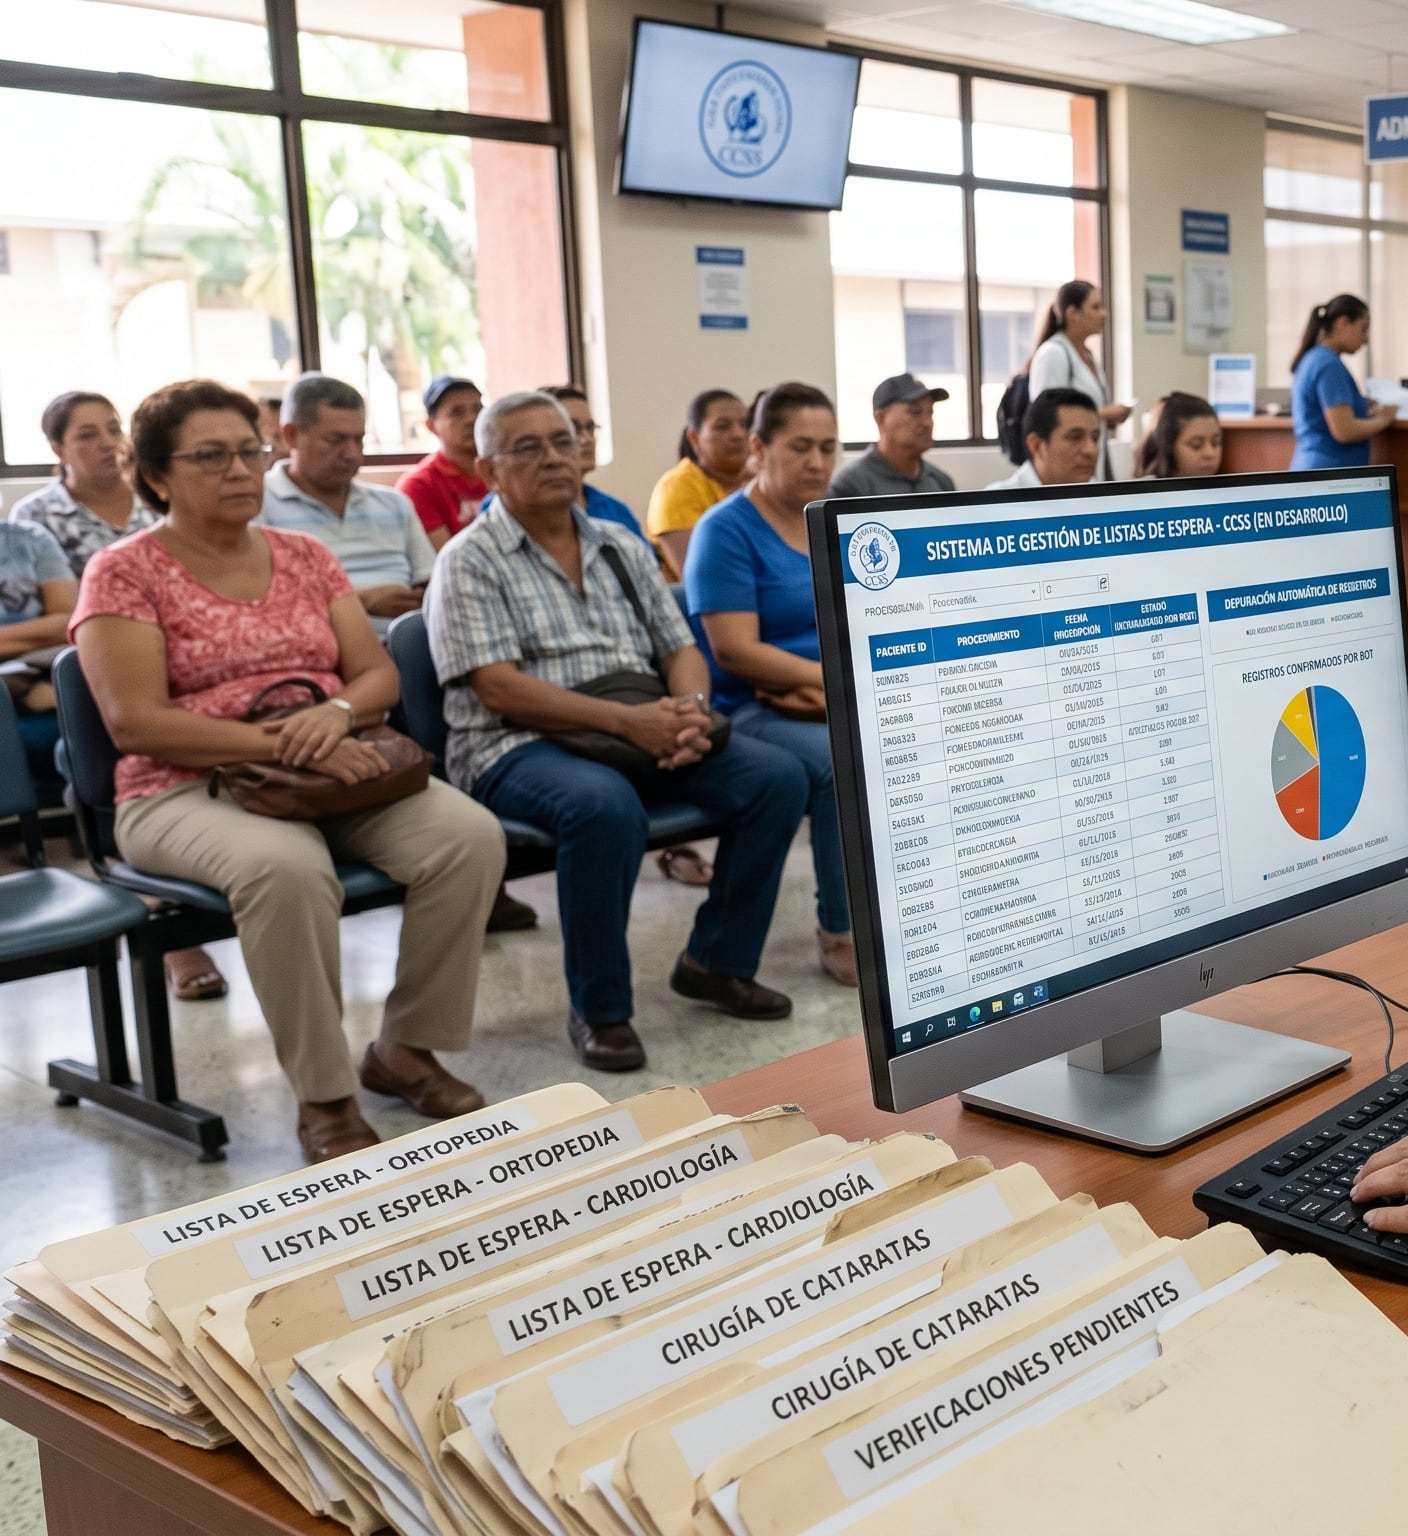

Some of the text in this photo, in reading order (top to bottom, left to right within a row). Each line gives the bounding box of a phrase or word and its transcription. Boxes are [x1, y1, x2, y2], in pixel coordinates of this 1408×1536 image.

[926, 537, 994, 561] SISTEMA
[996, 536, 1016, 554] DE
[1019, 526, 1081, 551] GESTIÓN
[1083, 528, 1102, 546] DE
[1104, 521, 1146, 543] LISTAS
[1148, 520, 1166, 538] DE
[1168, 516, 1214, 537] ESPERA
[1223, 514, 1251, 533] CCSS
[1253, 511, 1273, 533] (EN
[1275, 504, 1348, 529] DESARROLLO)
[1224, 591, 1276, 610] DEPURACIÓN
[1277, 584, 1328, 602] AUTOMÁTICA
[1327, 582, 1339, 595] DE
[876, 641, 927, 658] PACIENTE ID
[957, 629, 1020, 647] PROCEDIMIENTO
[1241, 649, 1374, 684] REGISTROS CONFIRMADOS POR BOT
[162, 1212, 237, 1243] LISTA
[238, 1198, 276, 1220] DE
[277, 1168, 372, 1208] ESPERA
[388, 1119, 520, 1170] ORTOPEDIA
[261, 1225, 338, 1263] LISTA
[339, 1210, 376, 1236] DE
[378, 1178, 473, 1223] ESPERA
[489, 1126, 620, 1184] ORTOPEDIA
[361, 1258, 437, 1301] LISTA
[438, 1242, 476, 1272] DE
[477, 1208, 571, 1257] ESPERA
[586, 1143, 738, 1215] CARDIOLOGÍA
[508, 1296, 583, 1342] LISTA
[583, 1278, 620, 1309] DE
[621, 1242, 713, 1294] ESPERA
[727, 1173, 875, 1248] CARDIOLOGÍA
[661, 1228, 932, 1366] CIRUGÍA DE CATARATAS
[771, 1273, 1041, 1420] CIRUGÍA DE CATARATAS
[854, 1280, 1181, 1471] VERIFICACIONES PENDIENTES
